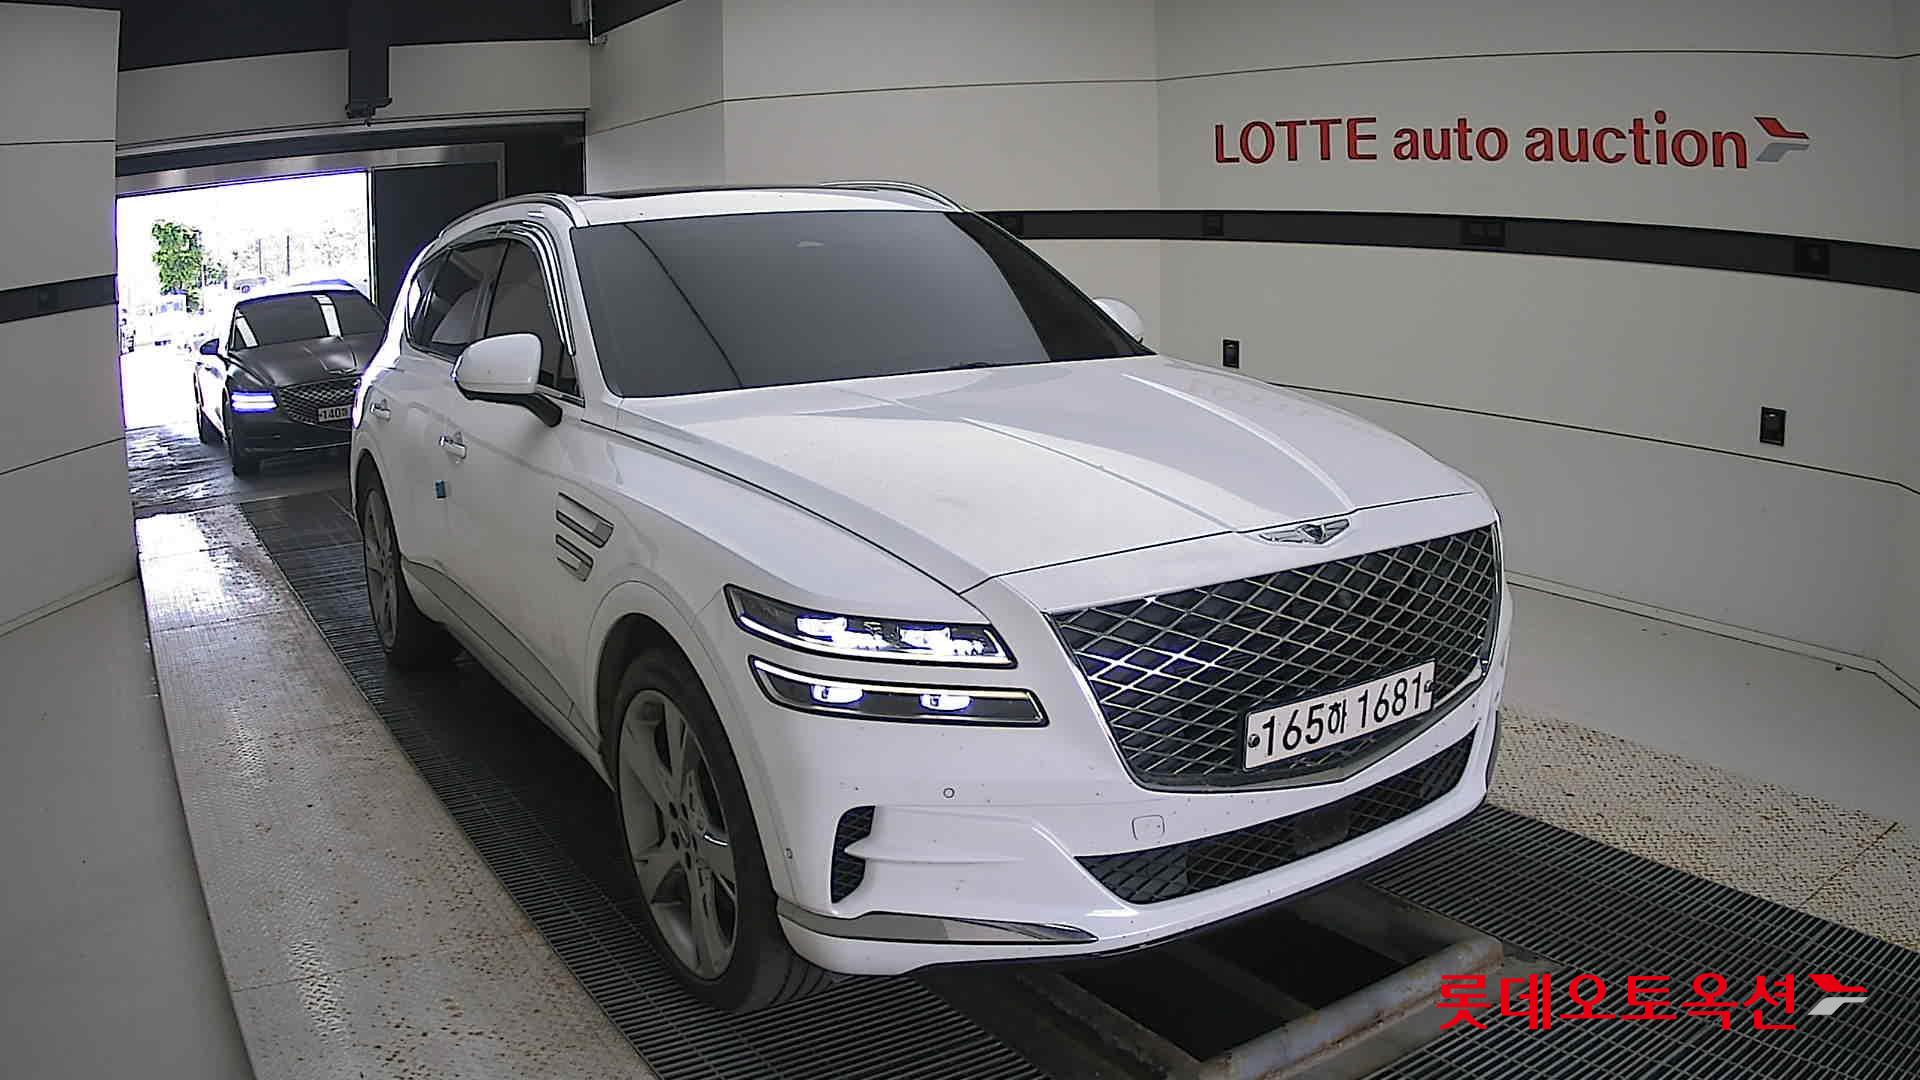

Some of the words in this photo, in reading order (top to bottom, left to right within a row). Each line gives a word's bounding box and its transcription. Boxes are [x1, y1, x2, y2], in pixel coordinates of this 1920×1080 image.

[1214, 116, 1377, 164] LOTTE
[1392, 117, 1509, 162] auto
[1524, 110, 1749, 169] auction
[1261, 699, 1348, 757] 165하
[1357, 671, 1423, 729] 1681
